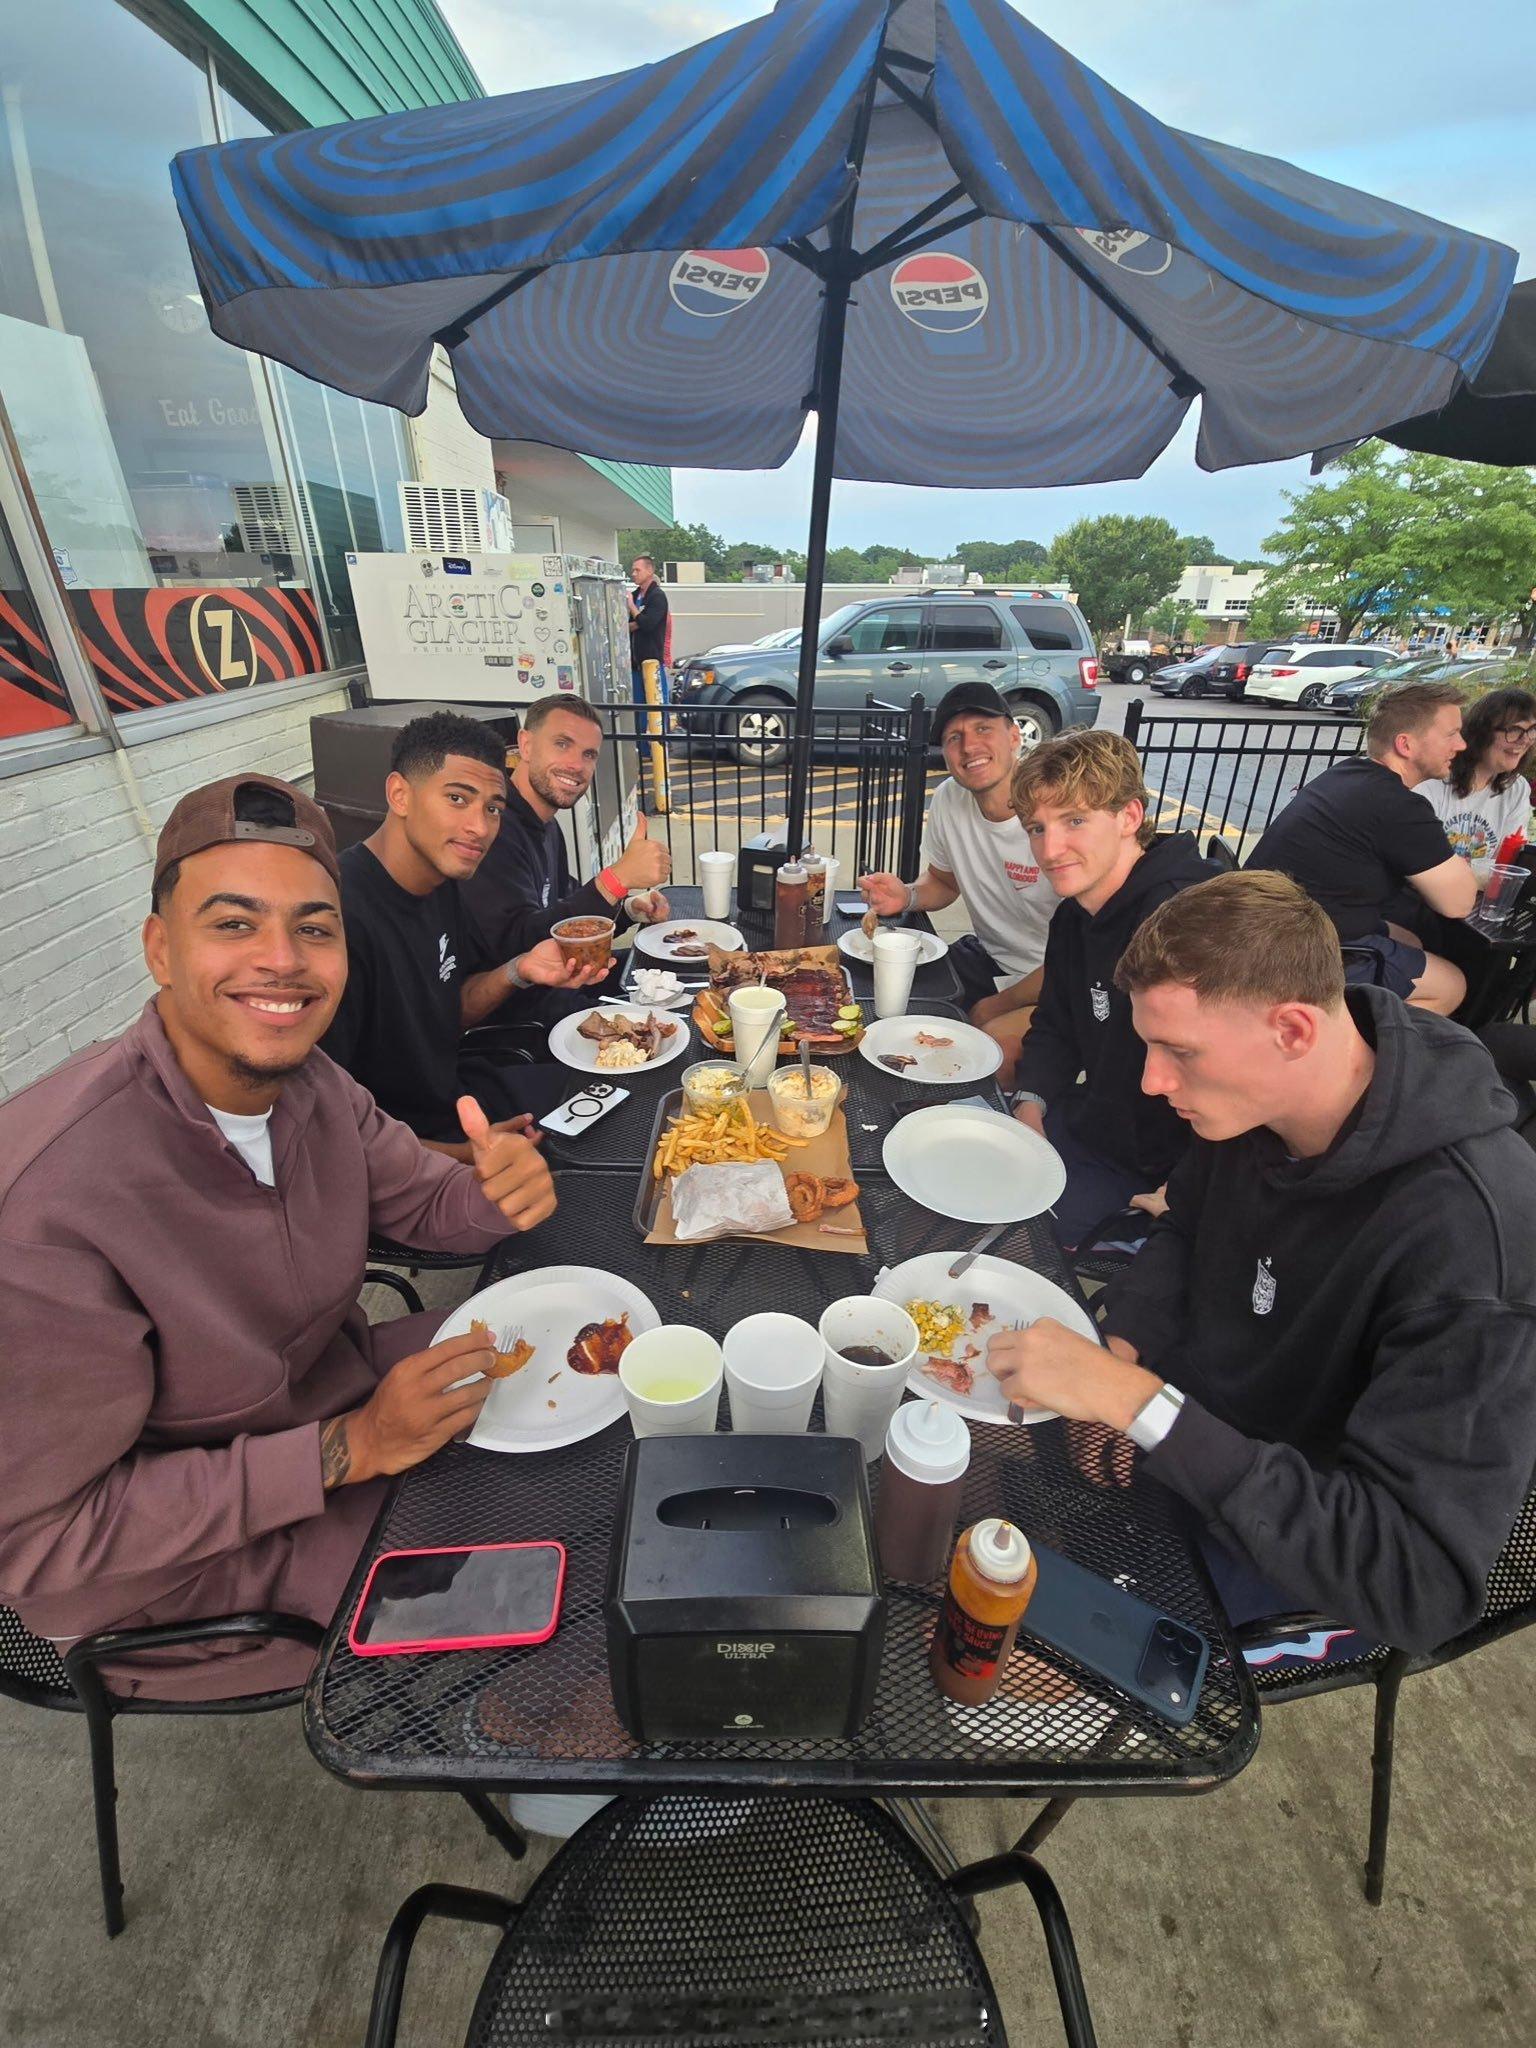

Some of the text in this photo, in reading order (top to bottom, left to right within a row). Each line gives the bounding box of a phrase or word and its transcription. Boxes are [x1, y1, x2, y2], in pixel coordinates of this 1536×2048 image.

[159, 399, 201, 427] Eat
[403, 584, 522, 619] ARCTIC
[204, 609, 248, 680] Z
[408, 620, 526, 644] GLACIER
